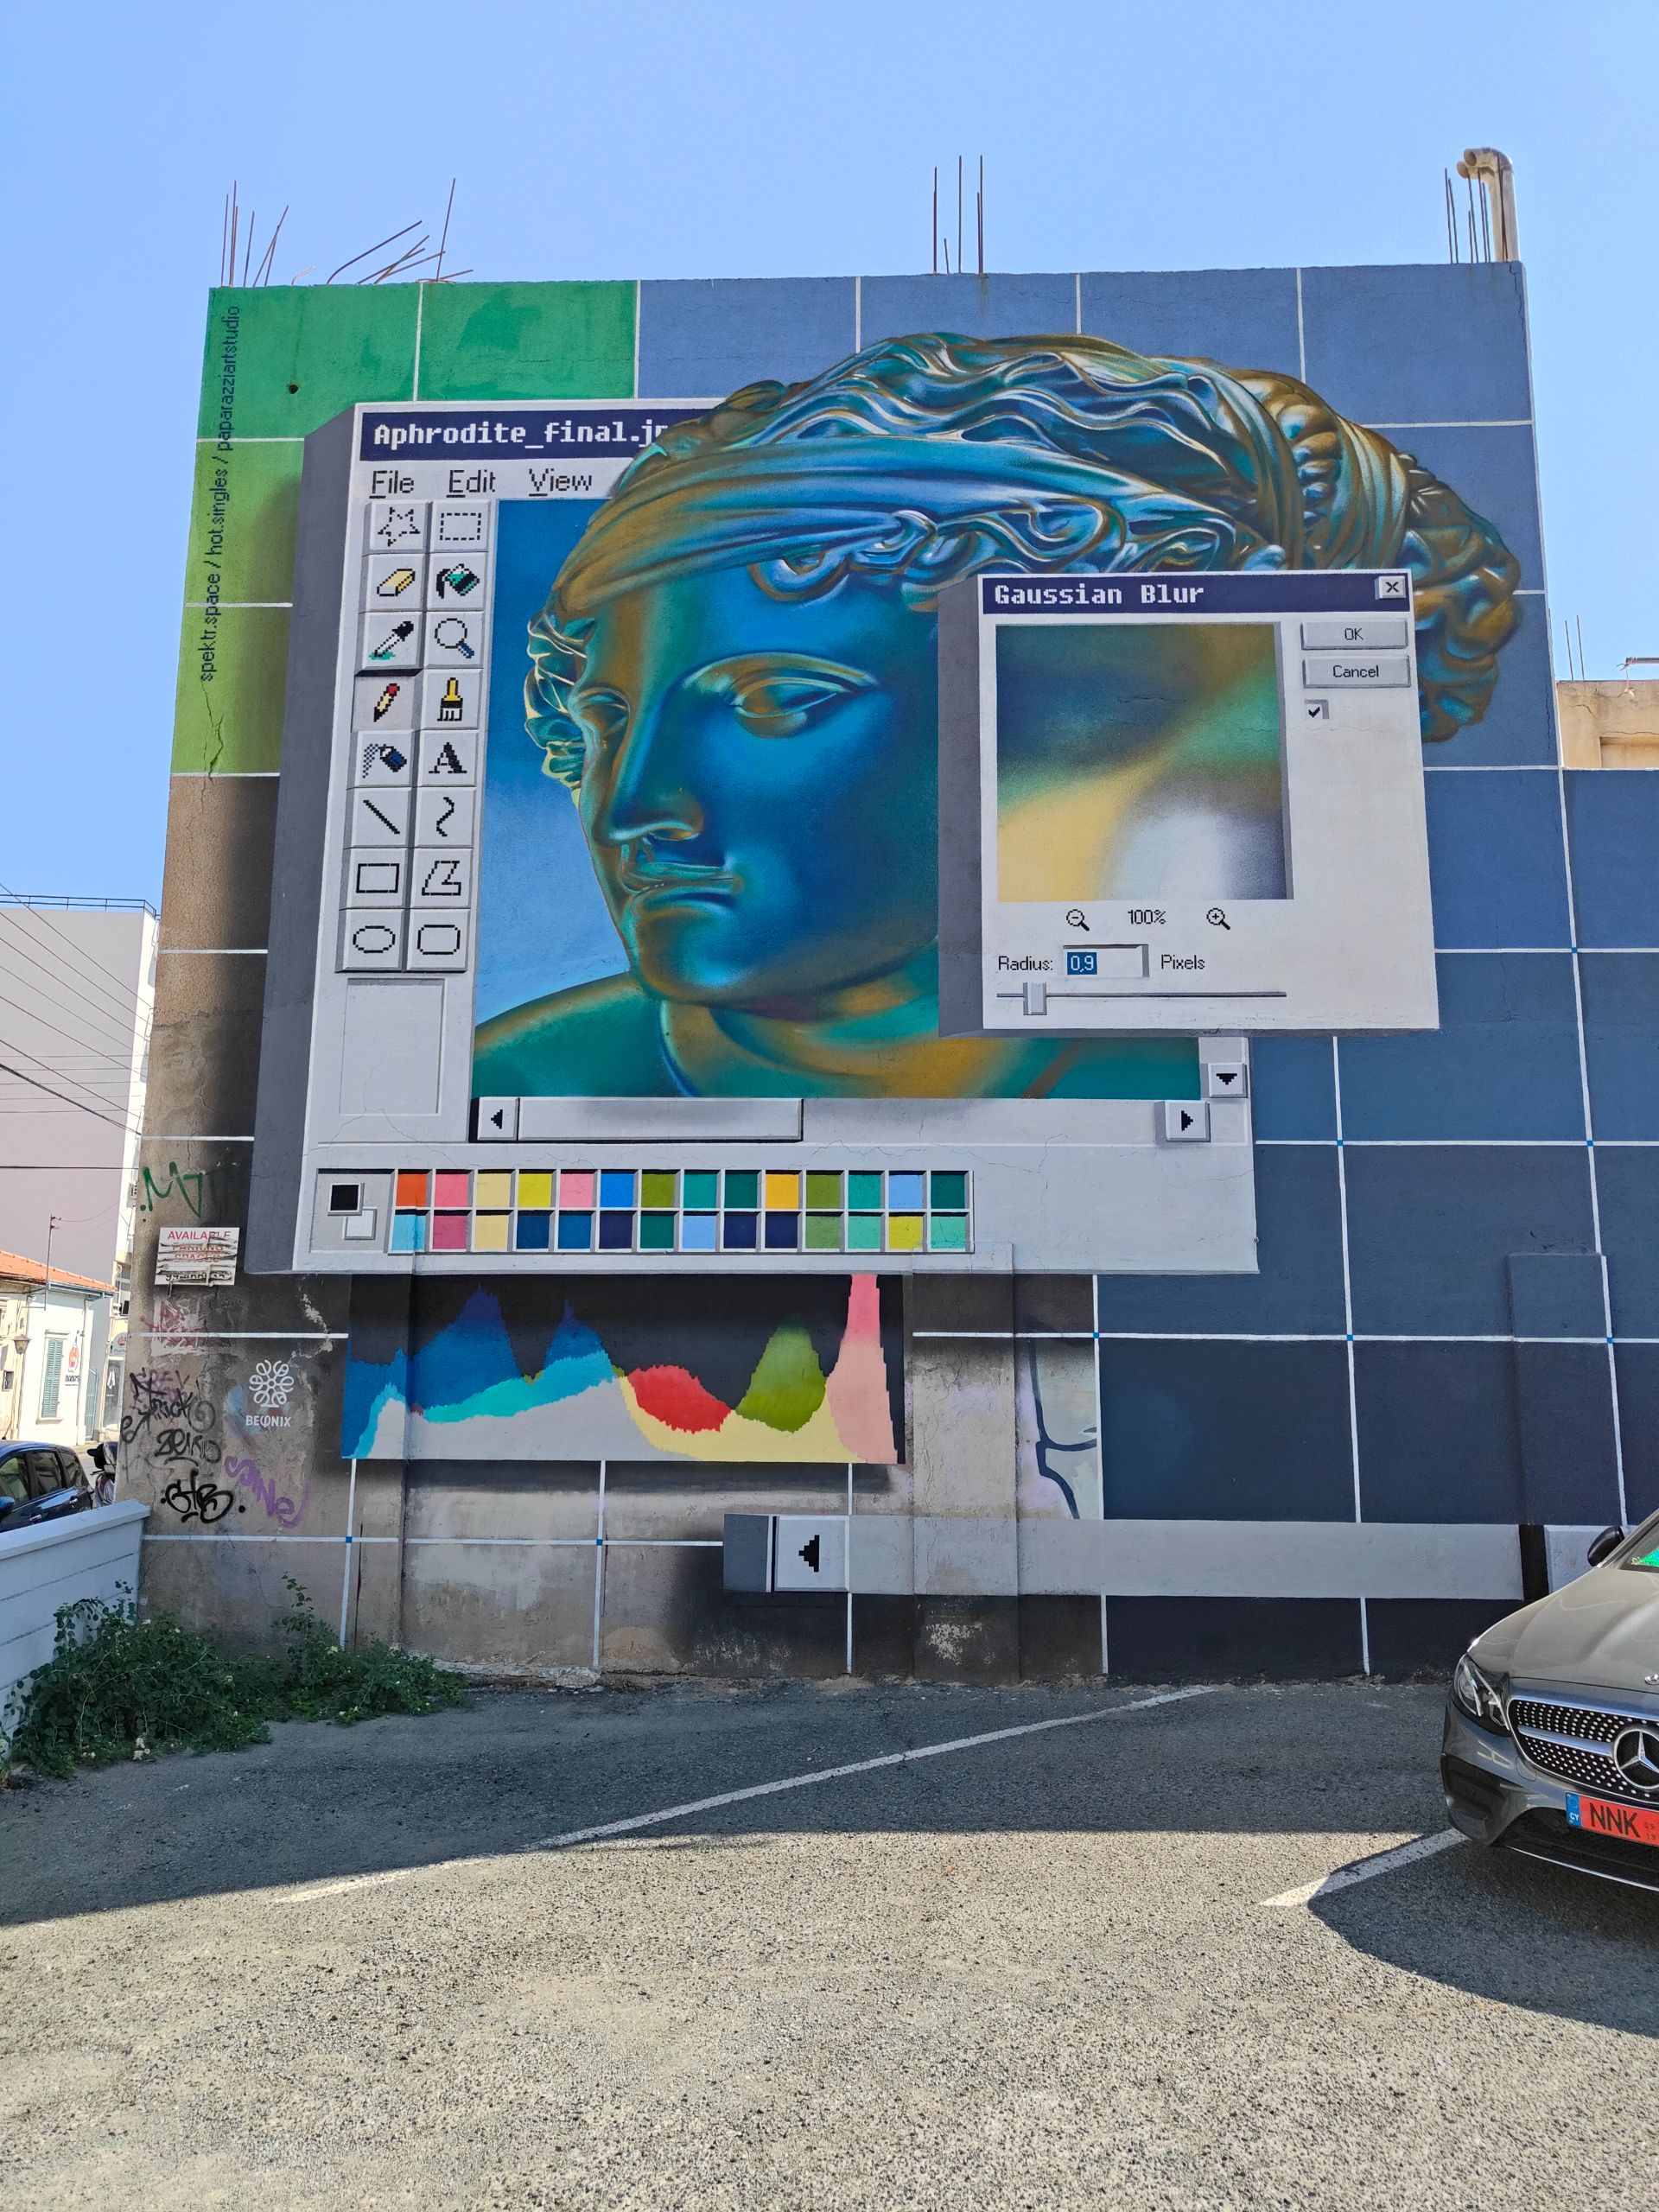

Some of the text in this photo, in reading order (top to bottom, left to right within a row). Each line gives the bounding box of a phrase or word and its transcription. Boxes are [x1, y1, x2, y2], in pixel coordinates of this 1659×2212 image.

[213, 306, 239, 451] paparazziartstudio
[369, 467, 593, 499] File Edit View
[205, 469, 230, 556] hot.singles
[995, 582, 1205, 605] Gaussian Blur
[198, 574, 221, 682] spektr.space
[1344, 627, 1363, 641] OK
[1332, 664, 1380, 679] Cancel
[1127, 909, 1166, 925] 100%
[998, 956, 1054, 972] Radius:
[1160, 954, 1205, 971] Pixels
[1589, 1802, 1641, 1839] NNK
